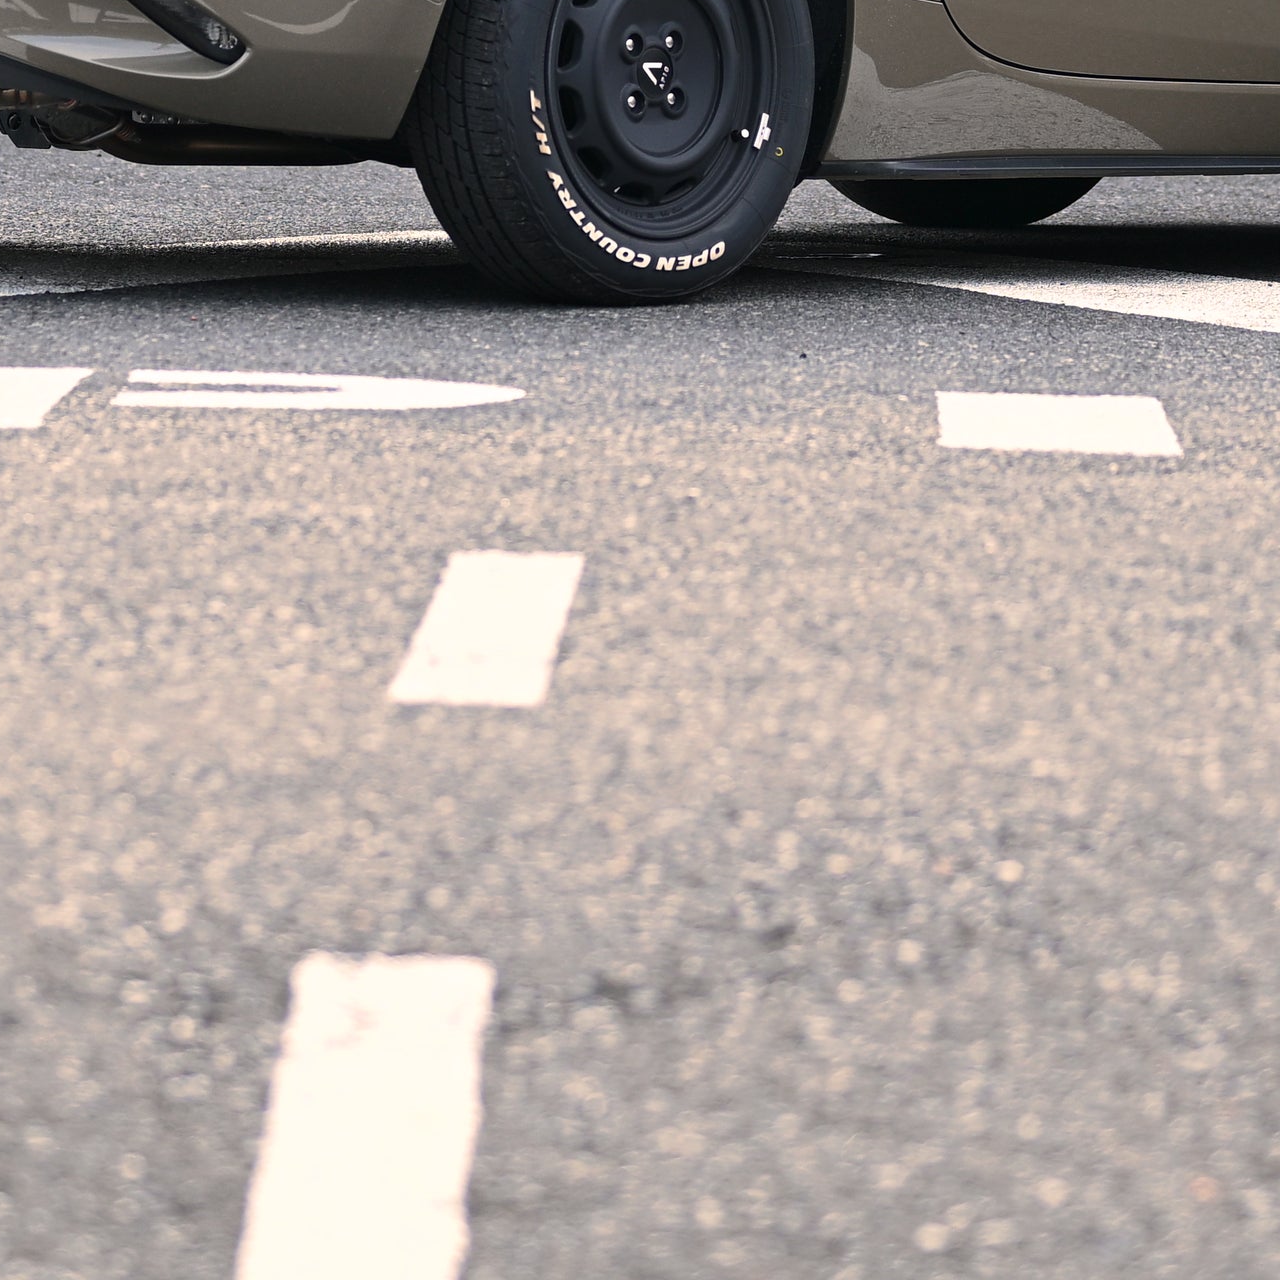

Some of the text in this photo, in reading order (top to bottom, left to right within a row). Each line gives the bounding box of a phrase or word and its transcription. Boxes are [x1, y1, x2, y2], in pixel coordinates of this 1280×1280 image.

[658, 65, 670, 90] APIO
[530, 89, 726, 271] OPEN COUNTRY H/T
